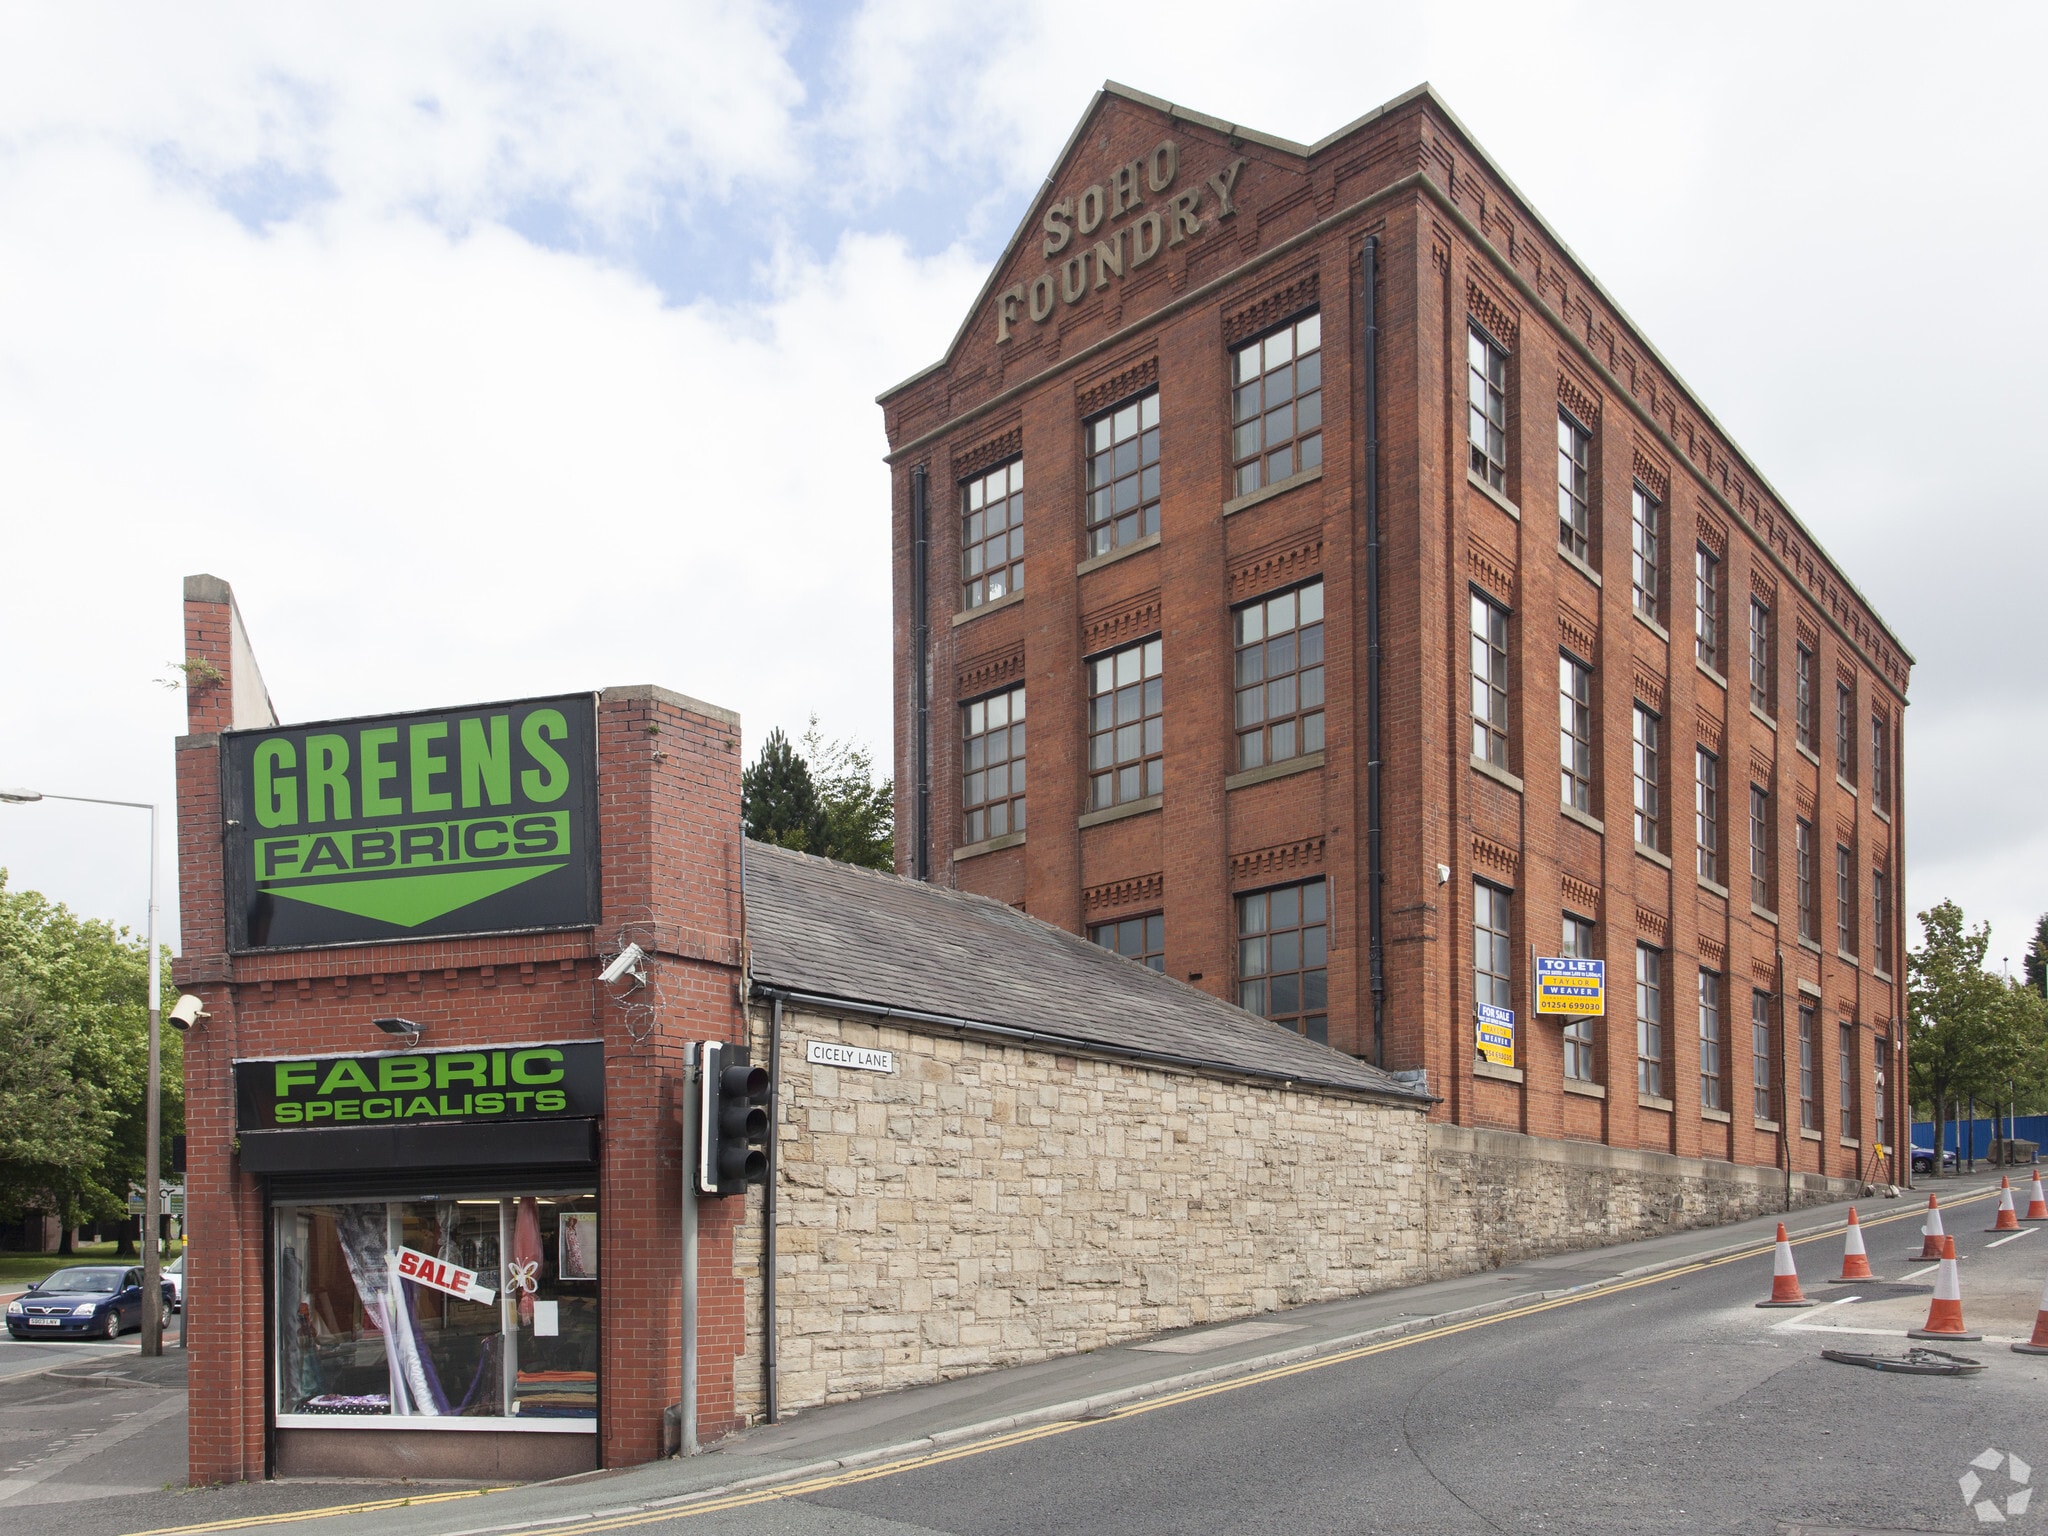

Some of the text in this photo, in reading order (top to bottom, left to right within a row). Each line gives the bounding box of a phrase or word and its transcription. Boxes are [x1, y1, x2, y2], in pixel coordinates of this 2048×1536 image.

[1043, 139, 1181, 260] SOHO
[995, 157, 1250, 345] FOUNDRY
[253, 708, 570, 829] GREENS
[263, 815, 559, 877] FABRICS
[1544, 960, 1596, 971] TO LET
[1550, 986, 1593, 995] WEAVER
[1553, 977, 1590, 986] TAYLOR
[1482, 1006, 1510, 1022] FOR SALE
[1541, 1001, 1600, 1010] 01254 699030
[1484, 1034, 1508, 1046] WEAVER
[813, 1046, 888, 1067] CICELY LANE
[275, 1048, 566, 1098] FABRIC
[274, 1089, 567, 1124] SPECIALISTS
[398, 1251, 471, 1294] SALE
